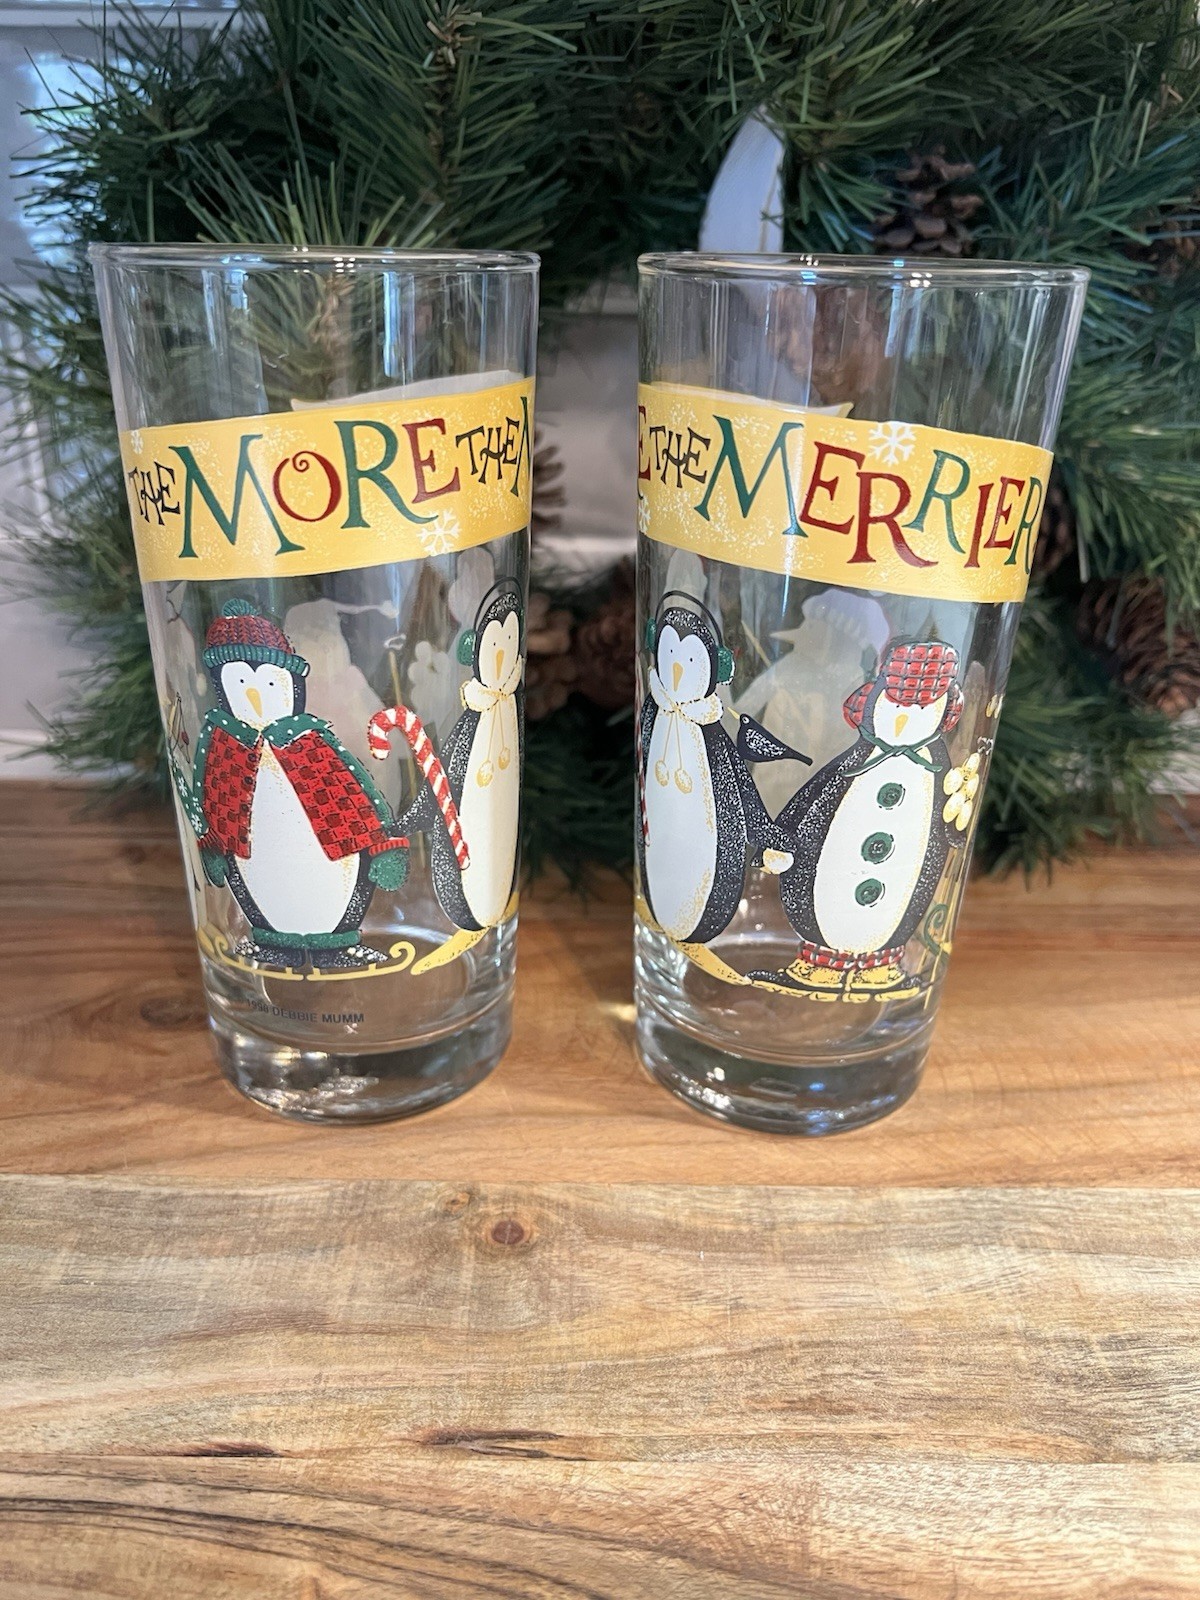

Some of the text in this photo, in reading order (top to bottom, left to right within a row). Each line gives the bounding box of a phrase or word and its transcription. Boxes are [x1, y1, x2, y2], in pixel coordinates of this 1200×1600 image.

[128, 461, 181, 526] THE
[168, 418, 461, 558] MORE
[455, 416, 520, 484] THE
[649, 425, 711, 489] THE
[694, 414, 1043, 575] MERRIER
[272, 1006, 318, 1023] DEBBIE
[321, 1013, 365, 1024] MUMM
